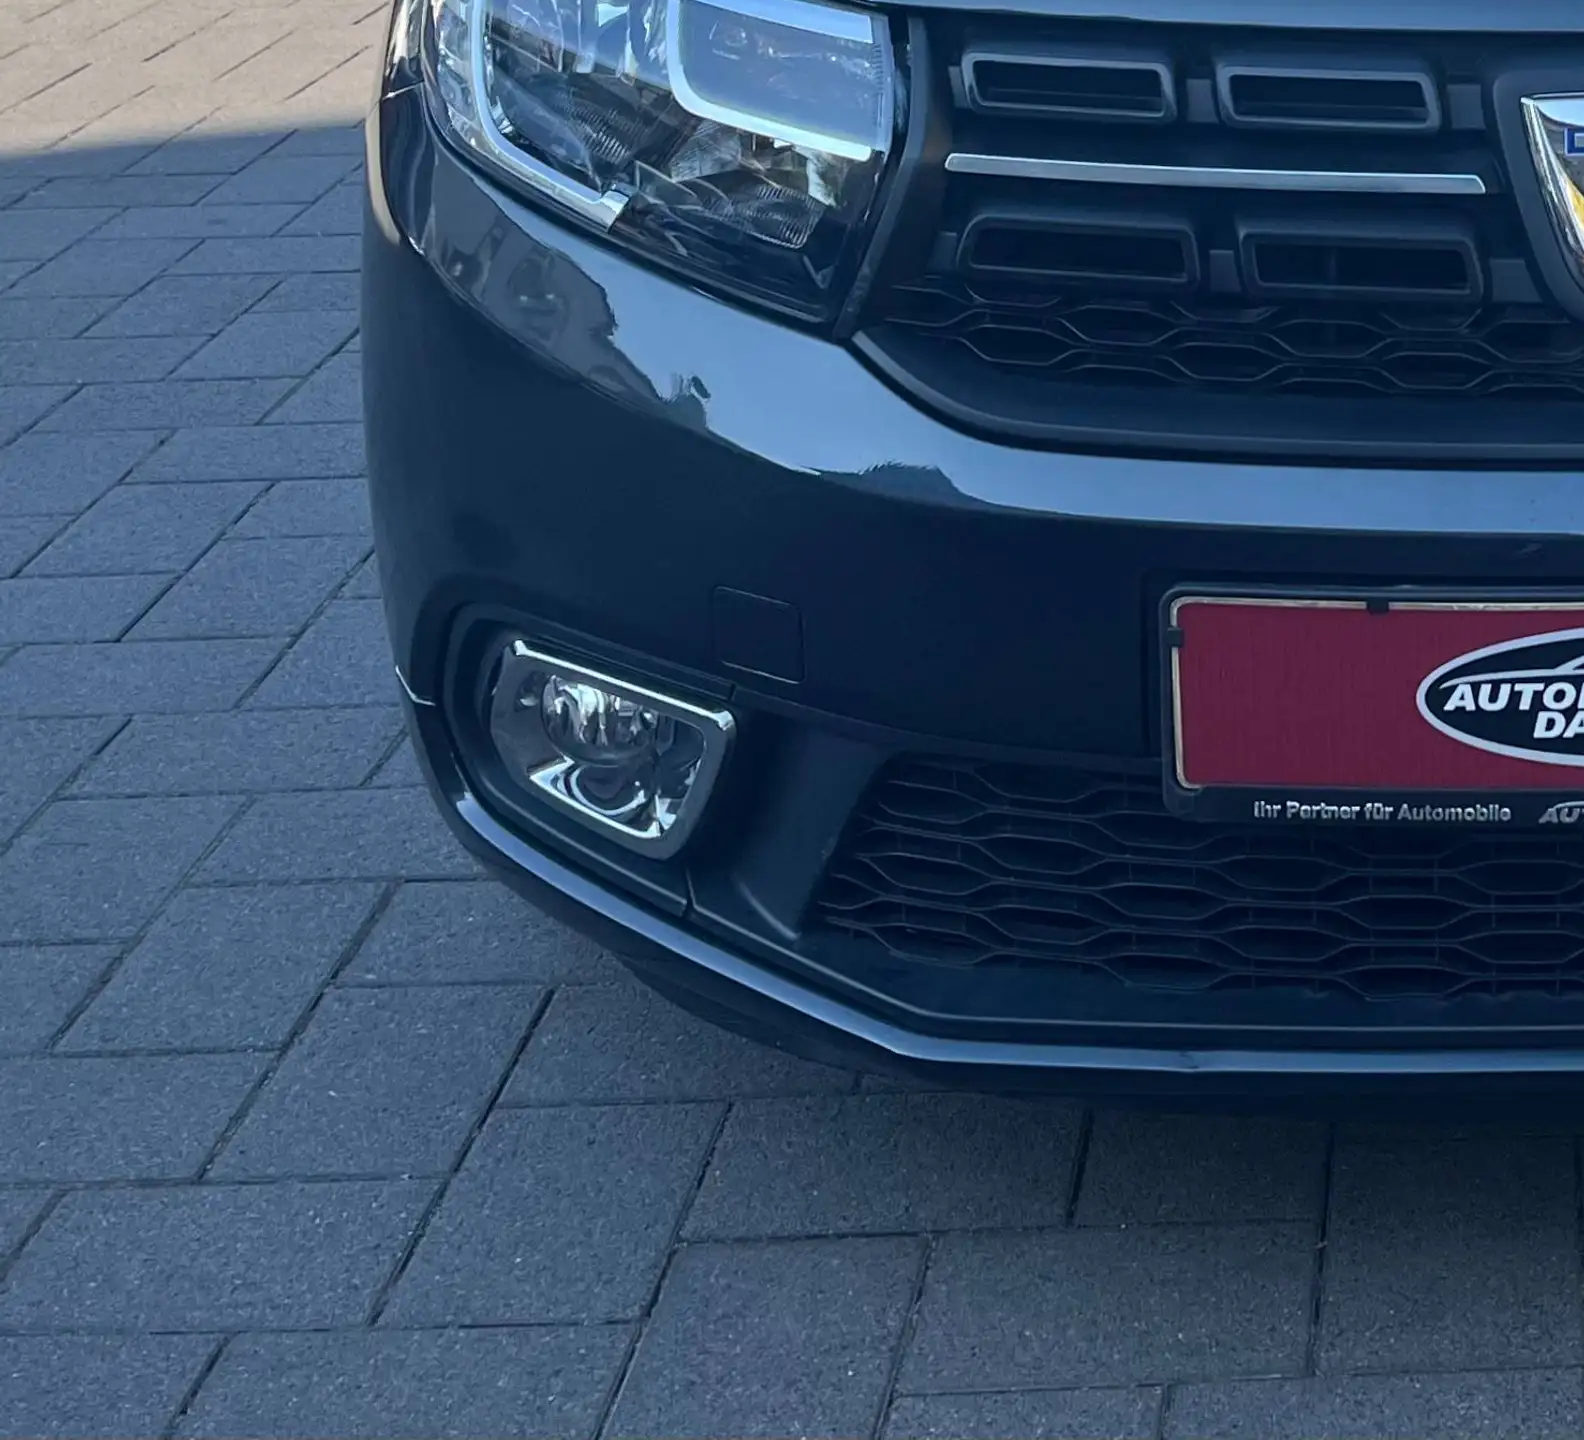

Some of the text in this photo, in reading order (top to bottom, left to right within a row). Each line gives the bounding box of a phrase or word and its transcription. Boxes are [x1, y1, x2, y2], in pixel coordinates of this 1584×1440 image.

[1253, 801, 1281, 820] Ihr
[1286, 801, 1360, 821] Partner
[1363, 801, 1395, 821] für
[1397, 803, 1512, 822] Automobile
